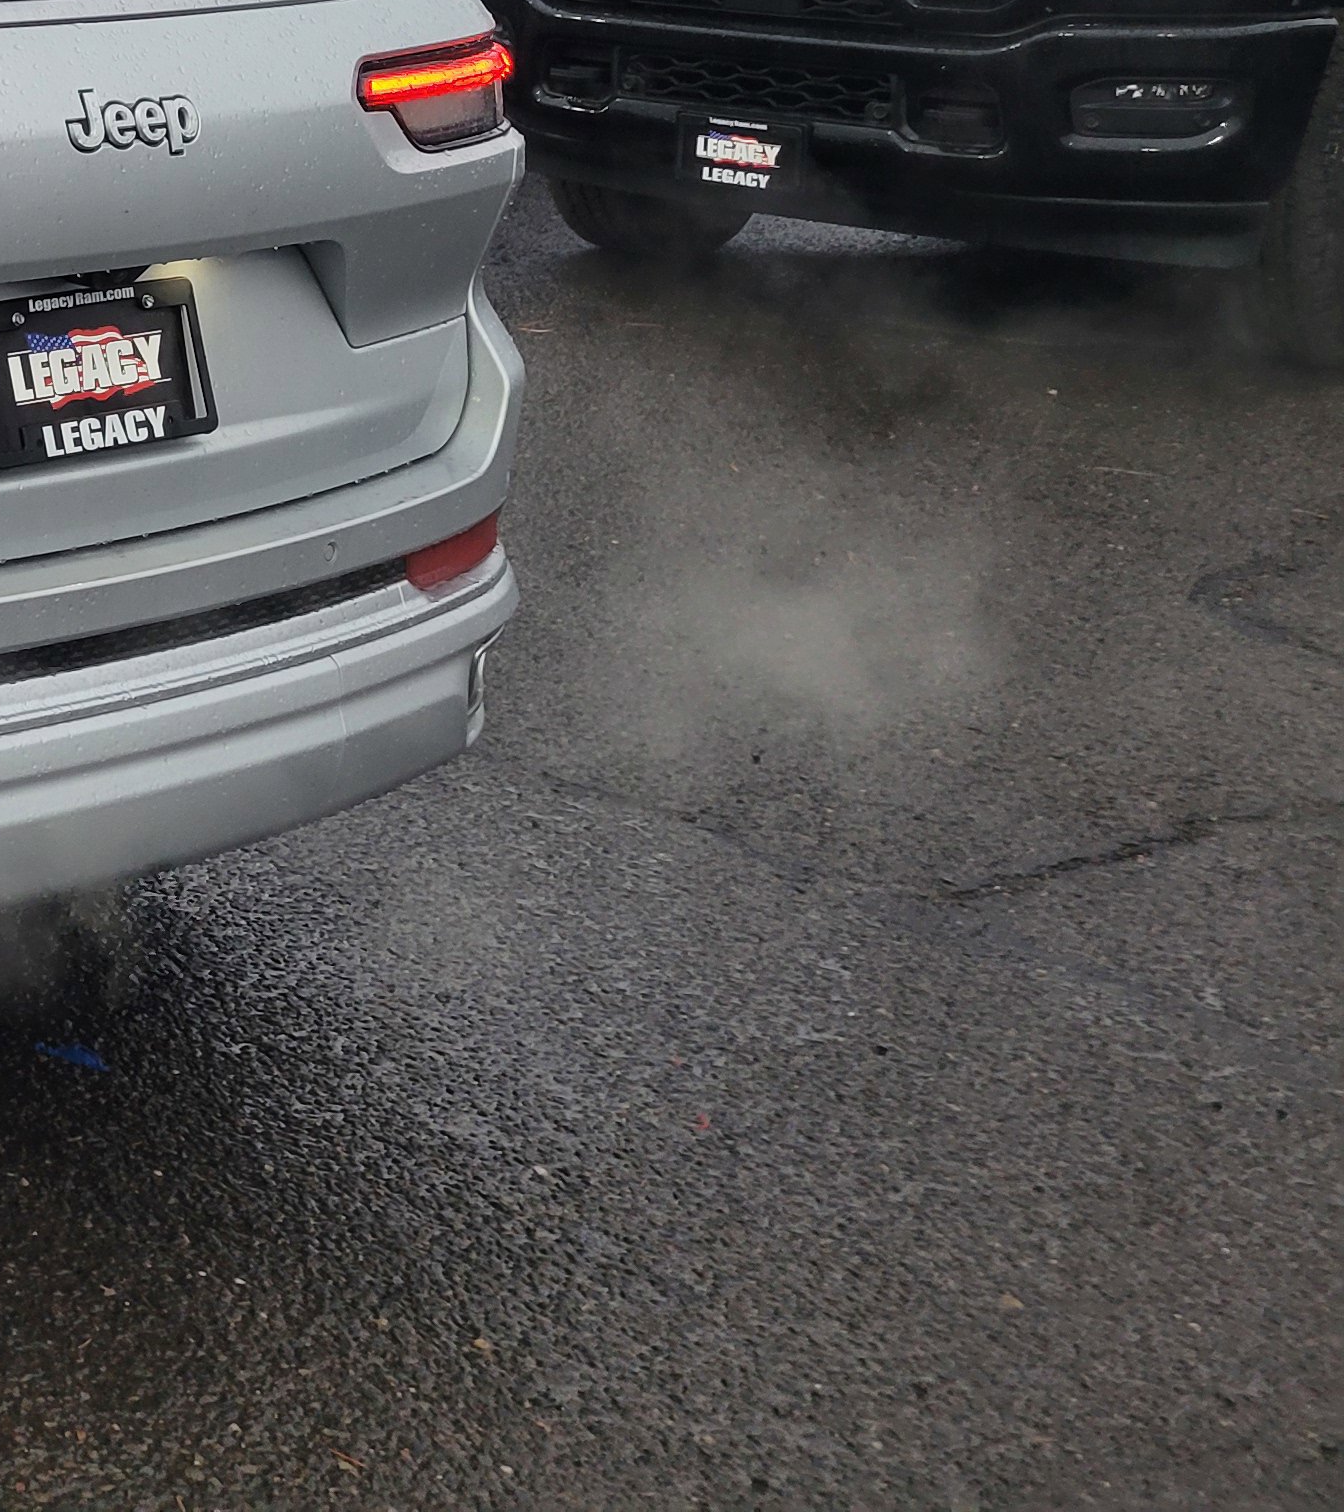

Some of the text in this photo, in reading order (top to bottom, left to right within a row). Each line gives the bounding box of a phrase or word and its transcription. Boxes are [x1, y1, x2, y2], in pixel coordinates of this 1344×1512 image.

[65, 88, 200, 156] Jeep
[696, 136, 782, 166] LEGACY
[702, 166, 771, 189] LEGACY
[7, 334, 162, 403] LEGACY
[42, 406, 166, 458] LEGACY
